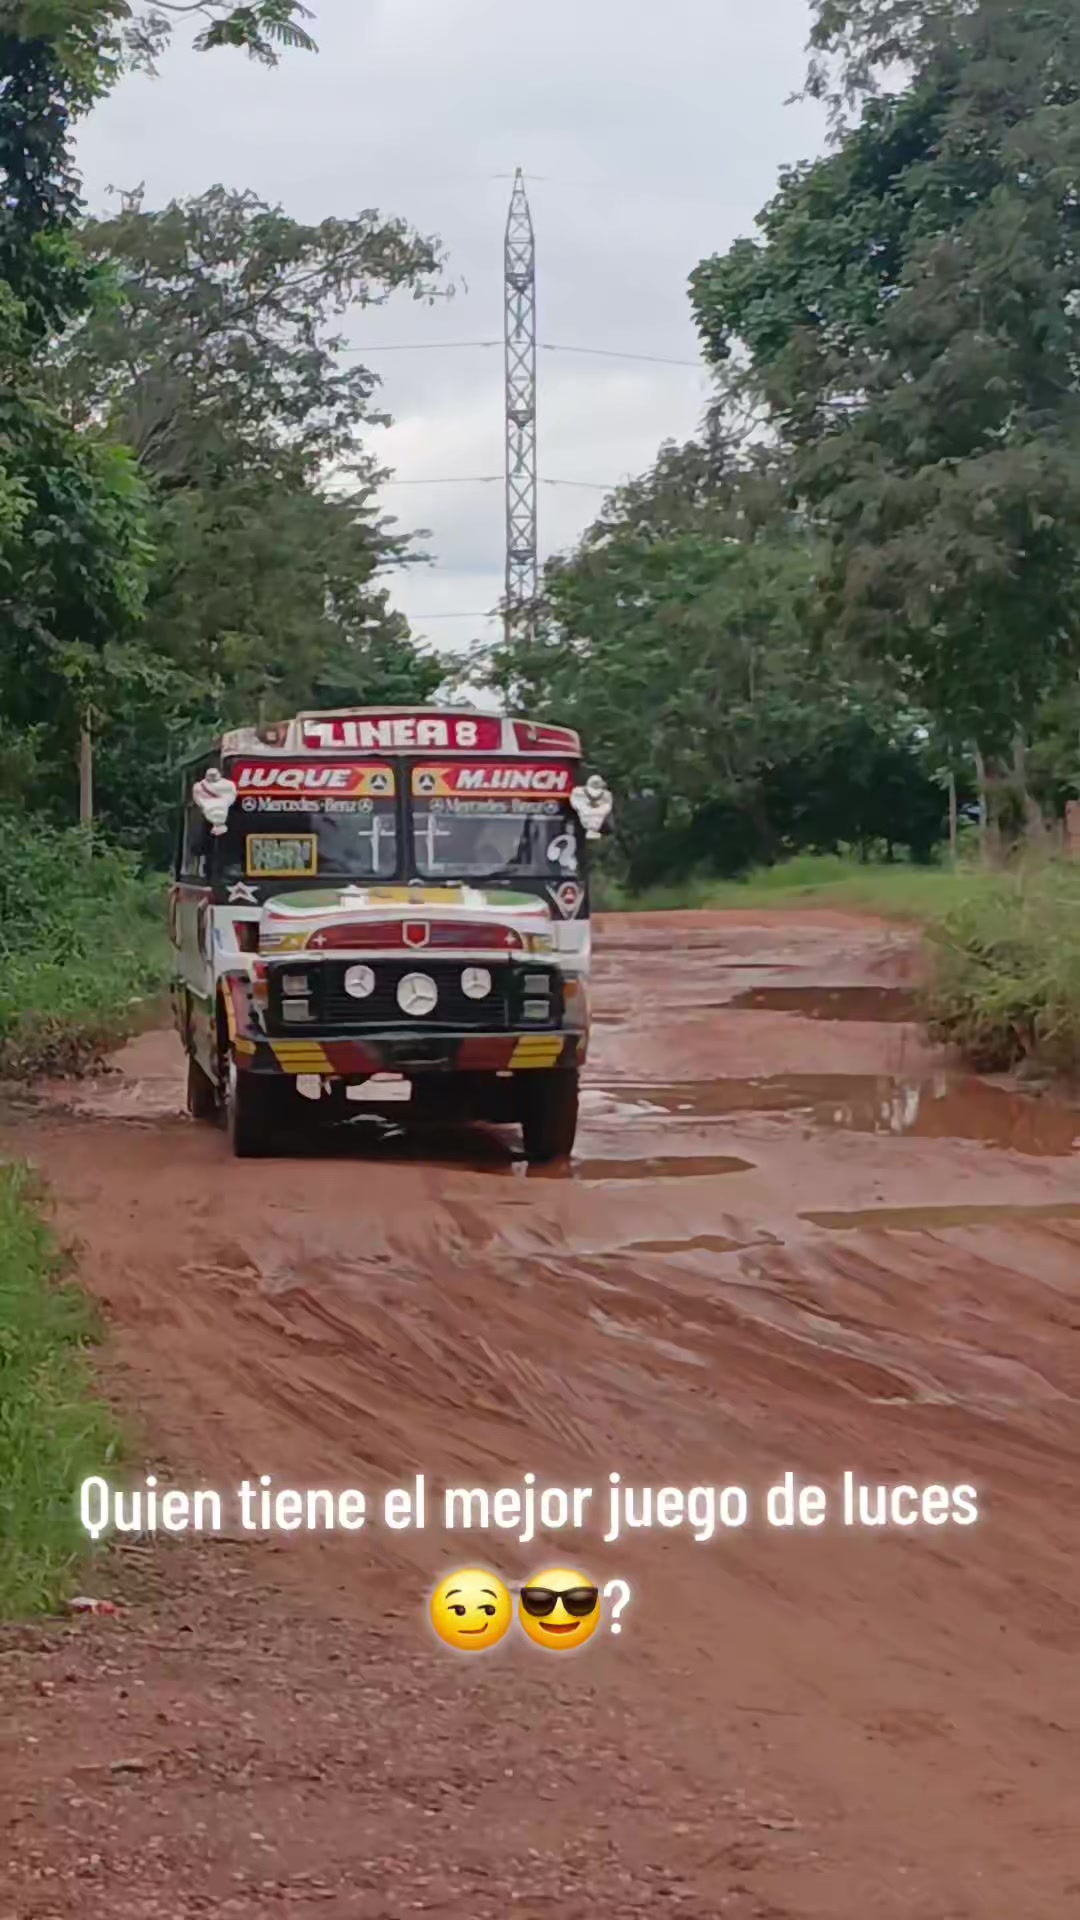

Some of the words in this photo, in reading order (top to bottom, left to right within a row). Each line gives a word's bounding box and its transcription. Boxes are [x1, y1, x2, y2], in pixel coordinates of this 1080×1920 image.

[304, 719, 449, 747] LINEA
[455, 721, 478, 746] 8
[238, 768, 353, 790] LUQUE
